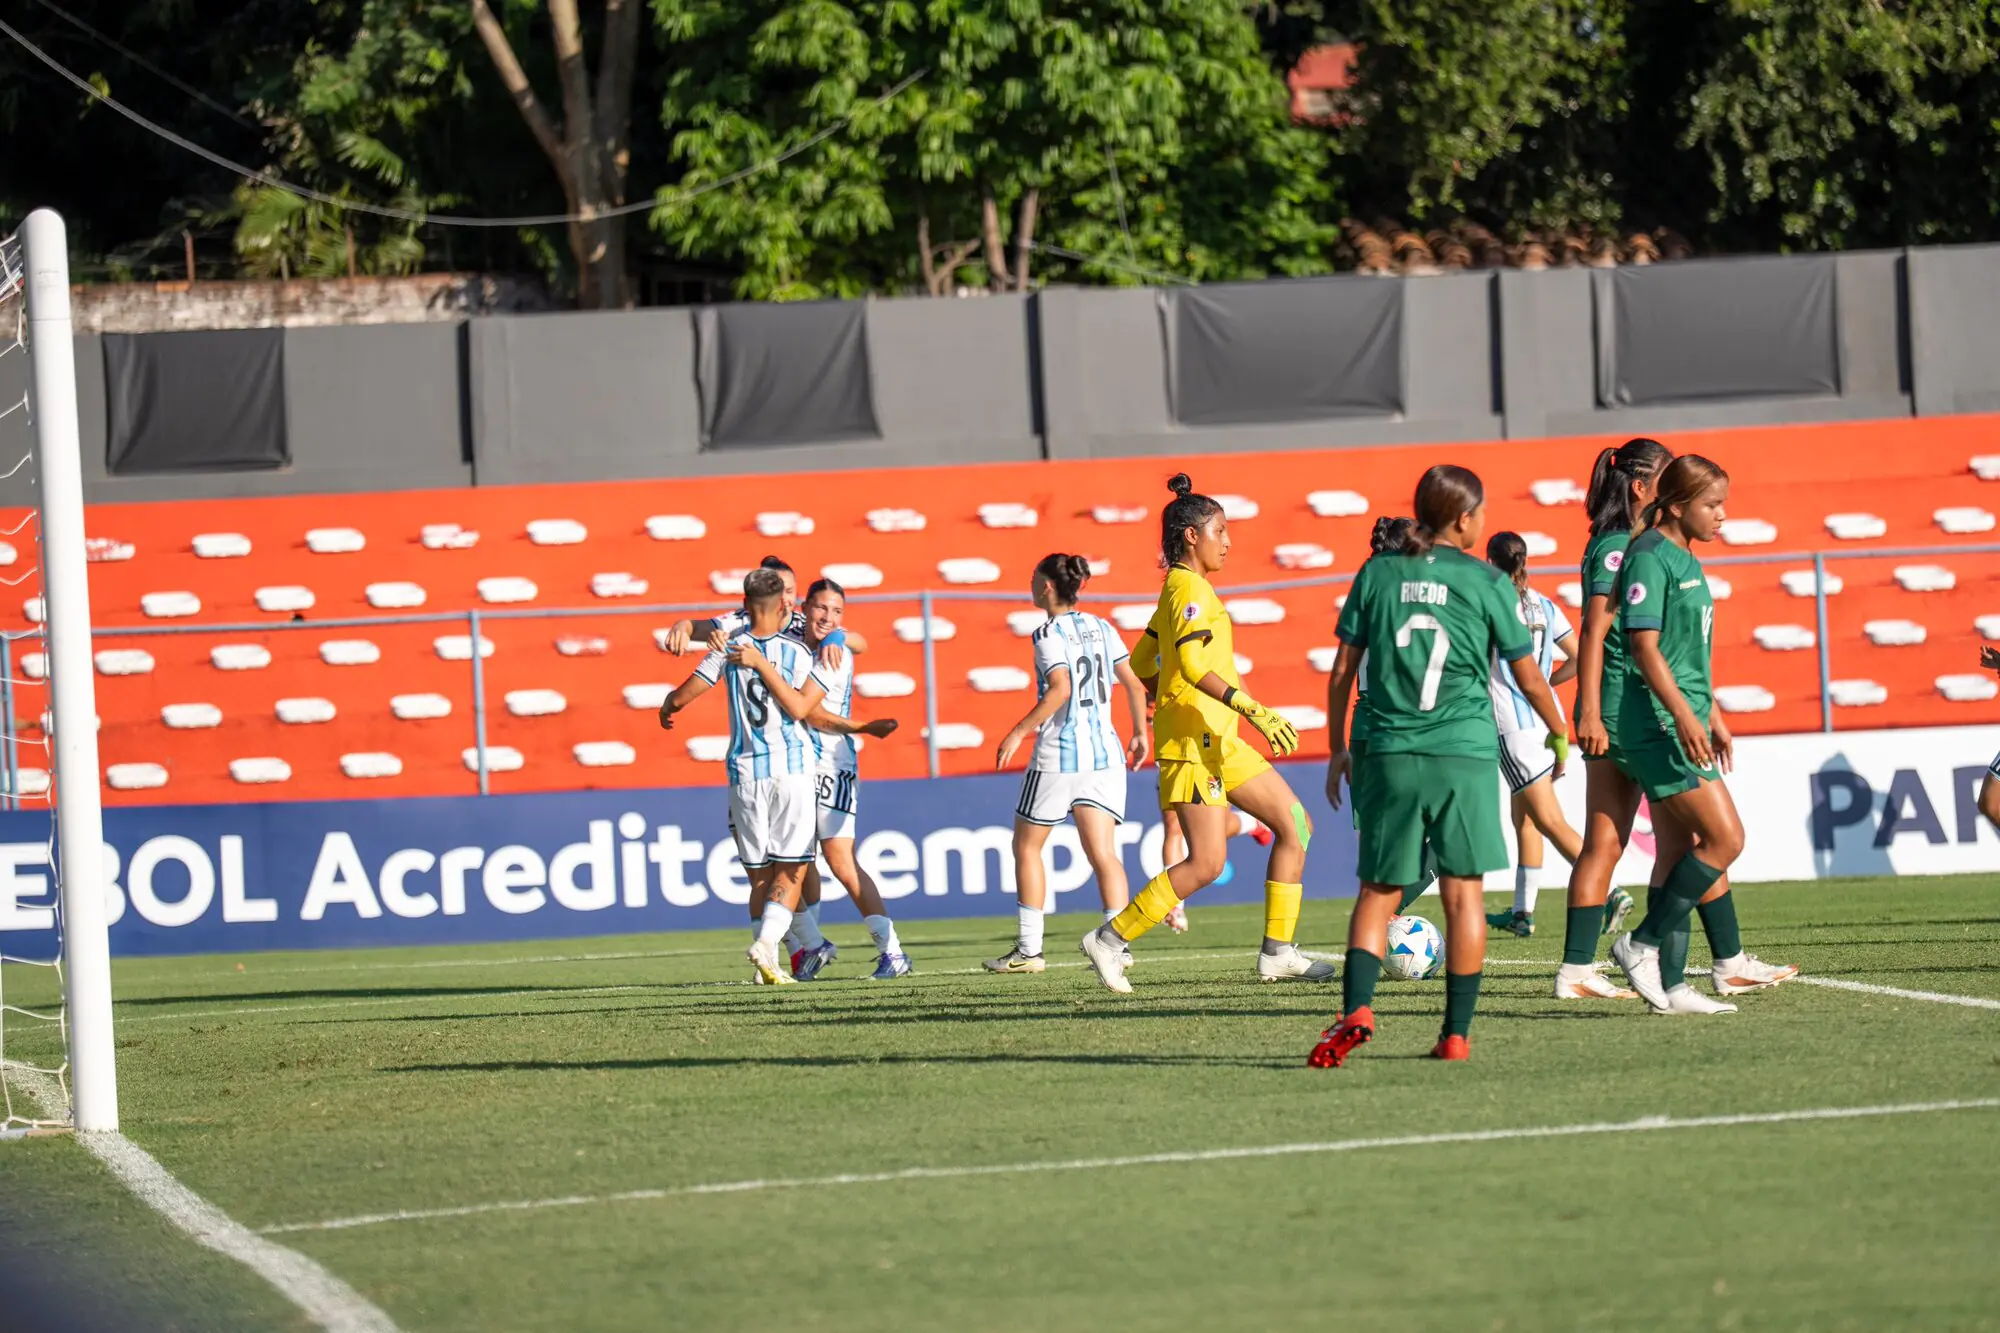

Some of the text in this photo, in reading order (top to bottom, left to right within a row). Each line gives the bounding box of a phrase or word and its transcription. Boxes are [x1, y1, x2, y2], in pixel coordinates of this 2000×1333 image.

[1401, 582, 1448, 605] RUEDA
[1076, 653, 1107, 708] 21
[1396, 614, 1450, 711] 7
[300, 811, 751, 921] Acredite
